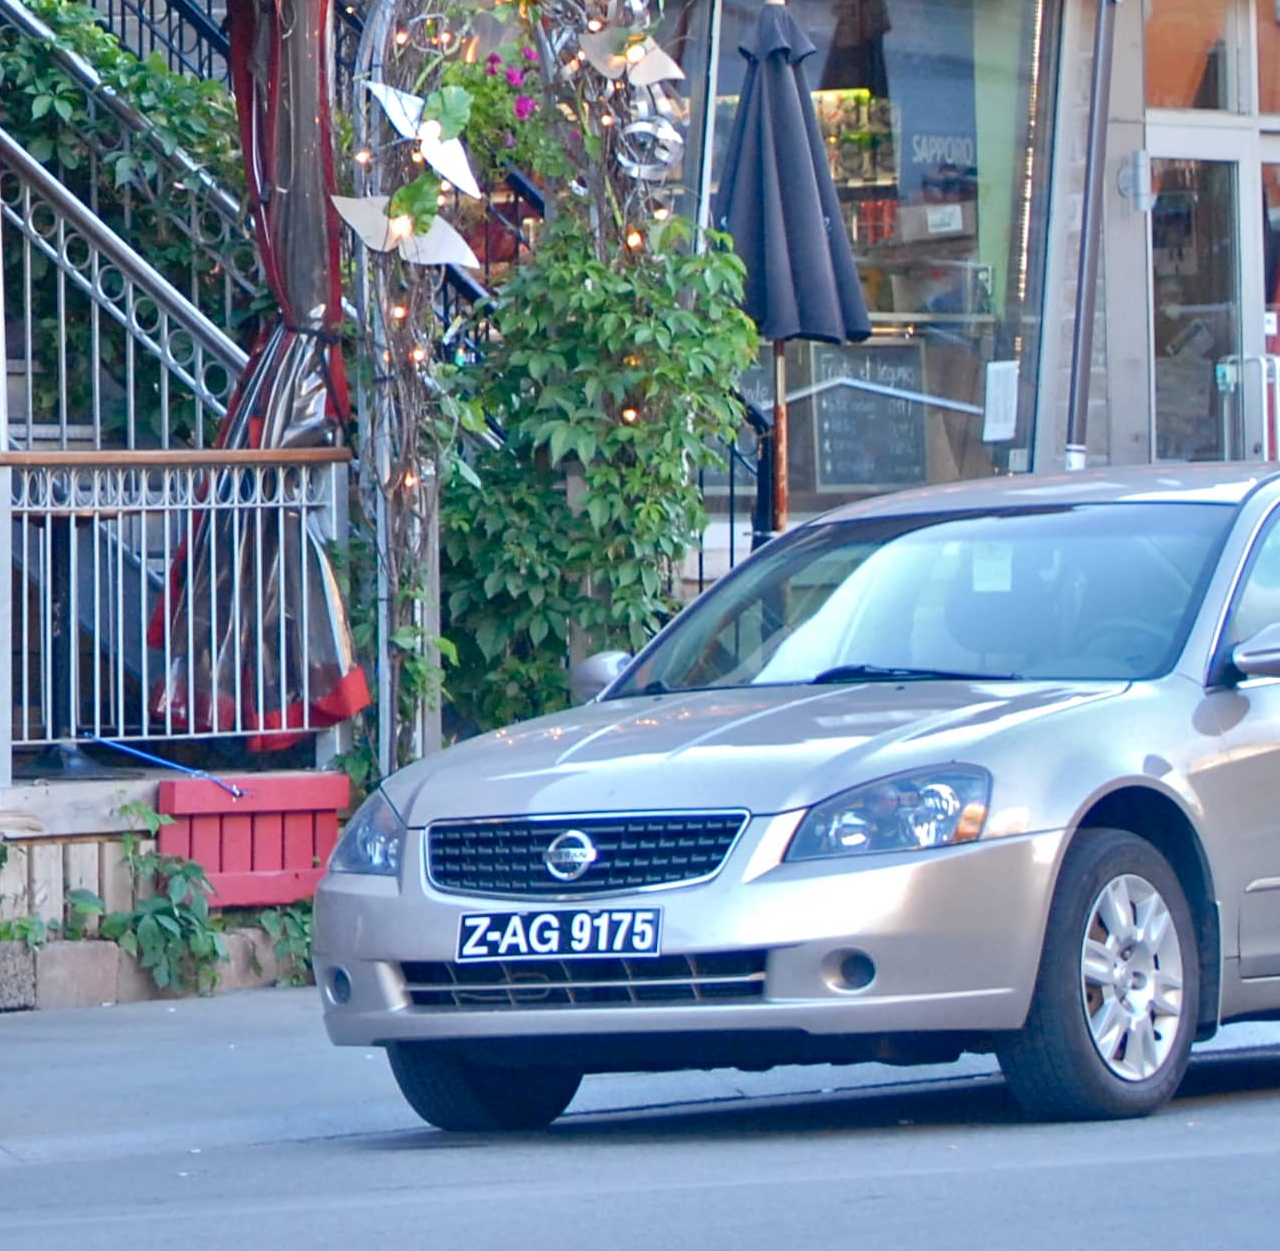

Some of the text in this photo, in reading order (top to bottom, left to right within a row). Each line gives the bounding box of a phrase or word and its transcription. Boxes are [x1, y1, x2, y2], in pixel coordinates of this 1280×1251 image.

[912, 134, 973, 166] SAPPORO
[462, 912, 654, 956] Z-AG 9175
